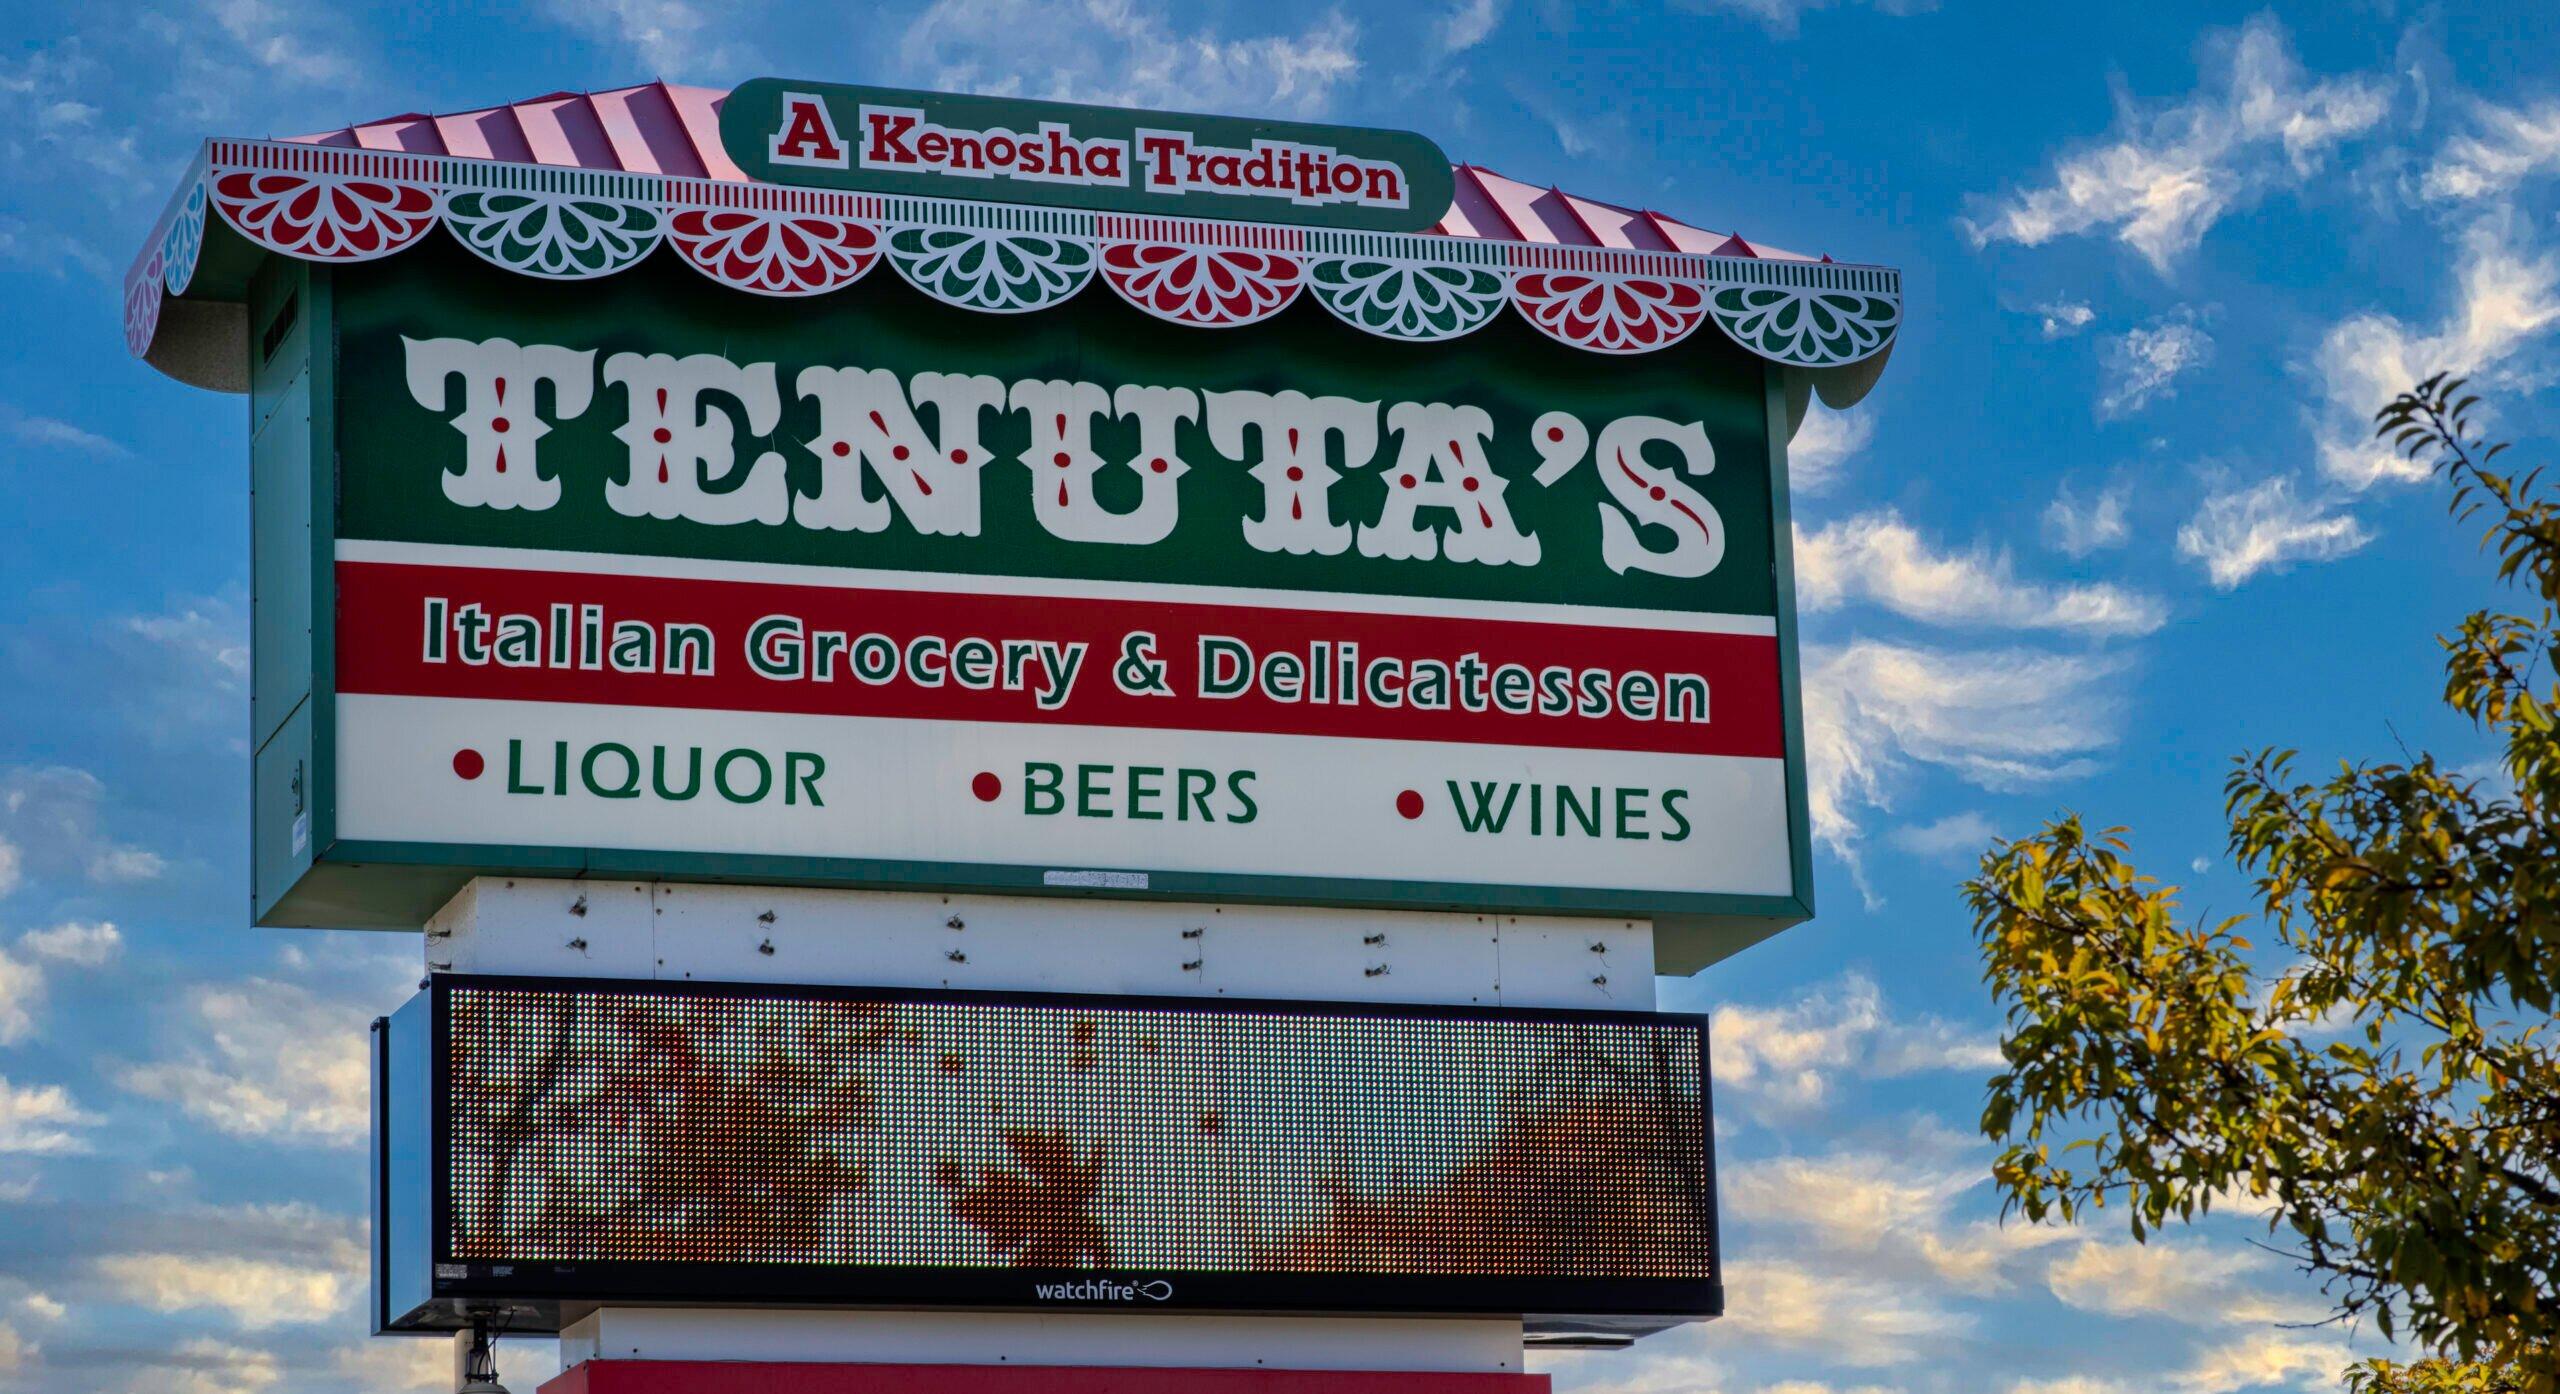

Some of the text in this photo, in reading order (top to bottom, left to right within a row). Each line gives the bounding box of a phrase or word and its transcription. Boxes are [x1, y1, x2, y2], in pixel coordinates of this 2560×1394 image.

[772, 95, 1406, 206] A Kenosha Tradition
[400, 334, 1725, 578] TENUTA'S
[423, 597, 1711, 723] Italian Grocery & Delicatessen
[507, 739, 1692, 841] LIQUOR BEERS WINES
[1036, 1279, 1134, 1300] watchfire
